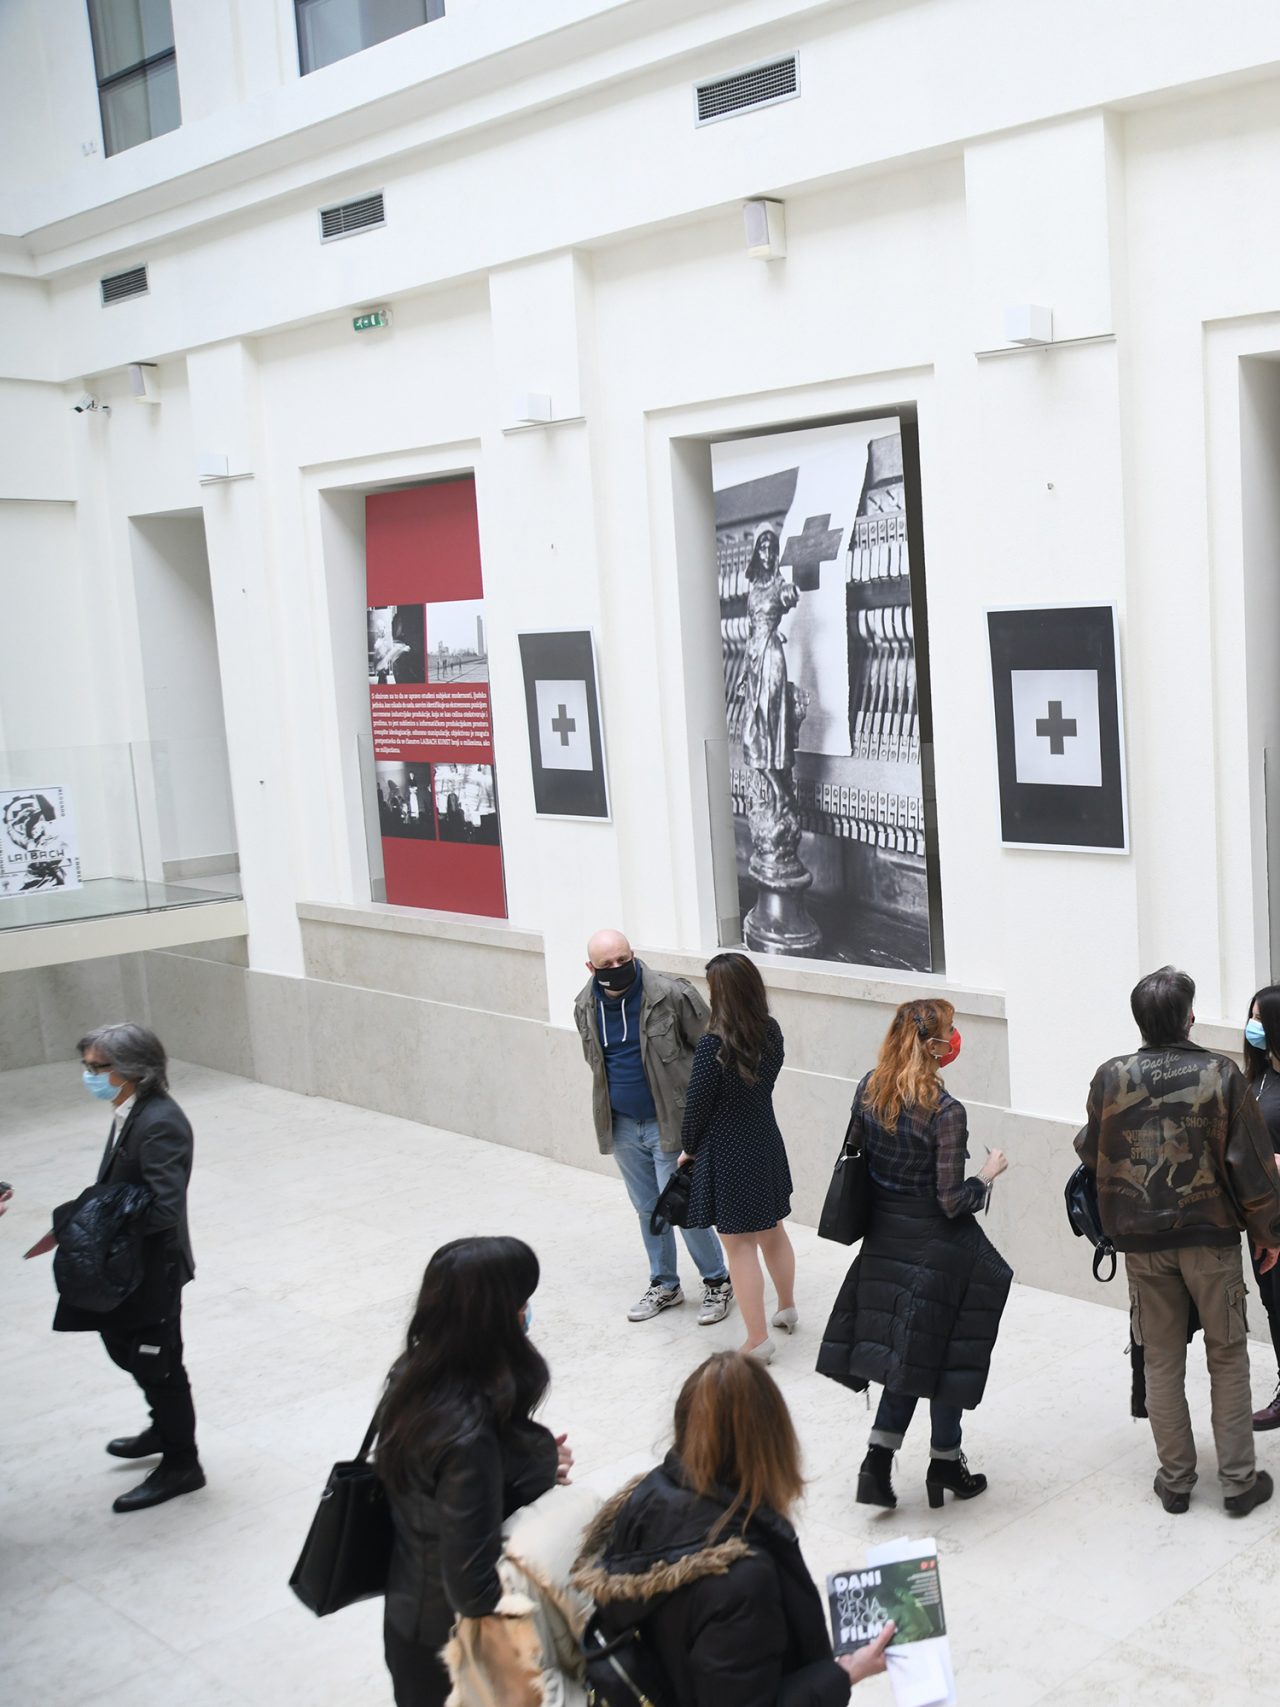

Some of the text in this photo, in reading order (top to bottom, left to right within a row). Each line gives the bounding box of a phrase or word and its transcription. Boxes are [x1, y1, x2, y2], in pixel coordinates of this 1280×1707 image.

[8, 849, 65, 863] LAIBACH
[1140, 1052, 1181, 1073] Pacific
[1151, 1064, 1199, 1085] Princess
[834, 1570, 882, 1592] DANI
[840, 1621, 888, 1643] FILM
